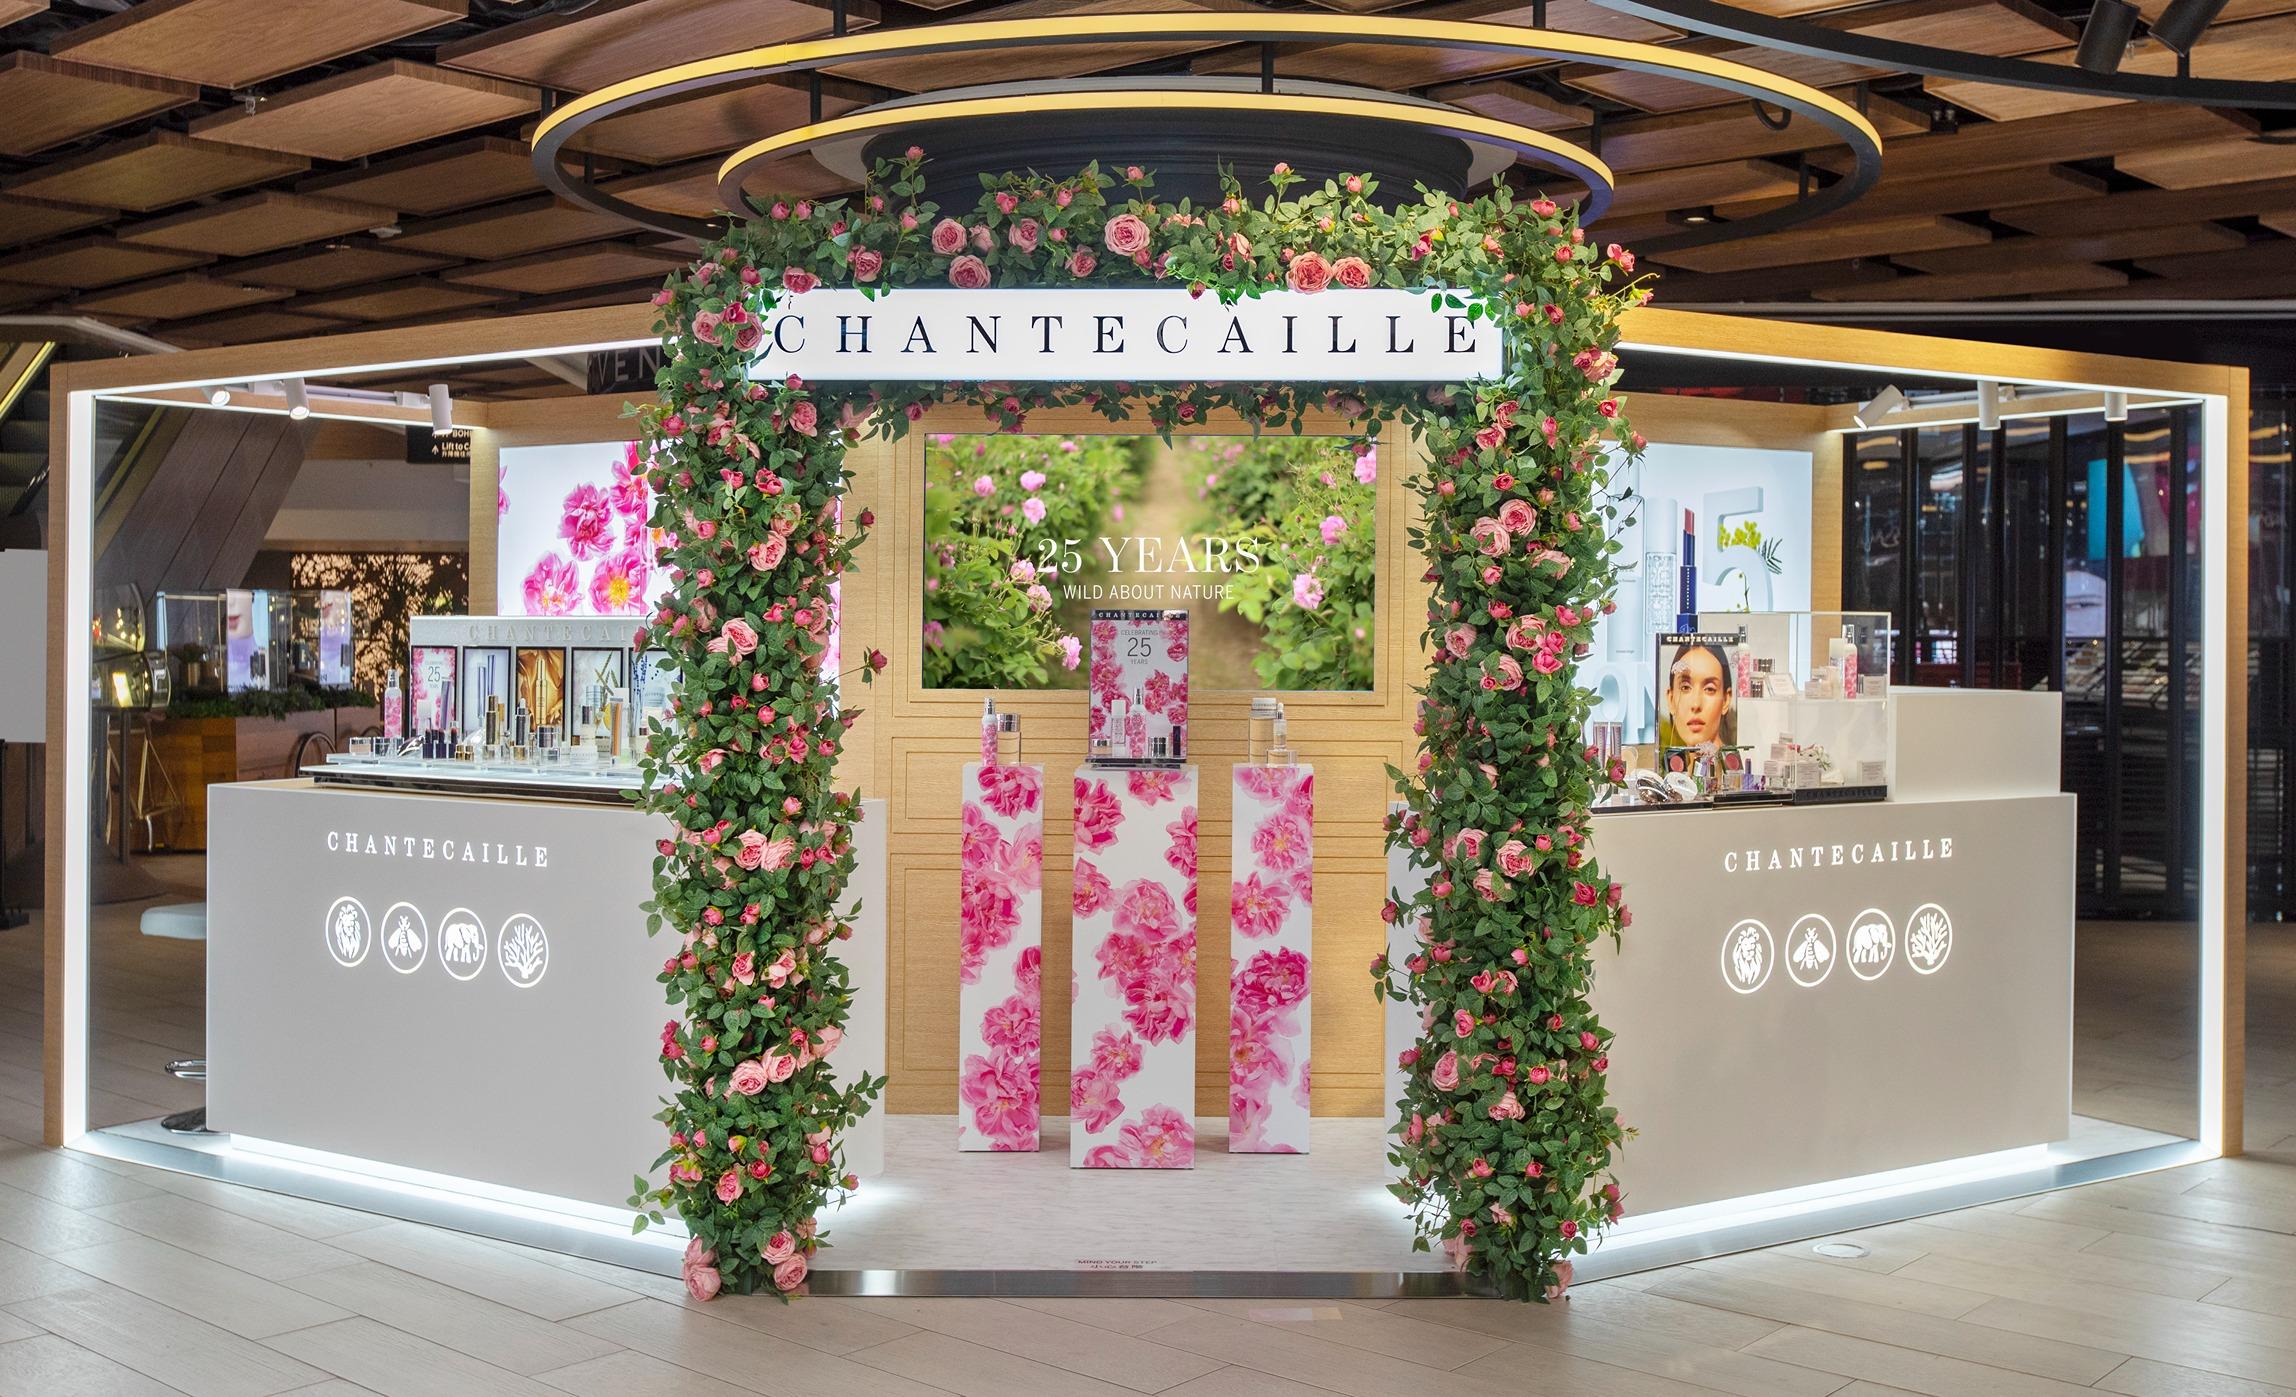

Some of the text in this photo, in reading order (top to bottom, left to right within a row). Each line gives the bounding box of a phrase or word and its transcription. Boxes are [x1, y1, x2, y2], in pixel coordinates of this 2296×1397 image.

[774, 314, 1477, 355] CHANTECAILLE
[441, 442, 454, 450] Lift
[455, 442, 463, 451] to
[1037, 535, 1261, 574] 25 YEARS
[1063, 584, 1234, 600] WILD ABOUT NATURE
[1127, 637, 1152, 657] 25
[427, 666, 441, 682] 25
[326, 831, 548, 868] CHANTECAILLE
[1724, 837, 1953, 873] CHANTECAILLE
